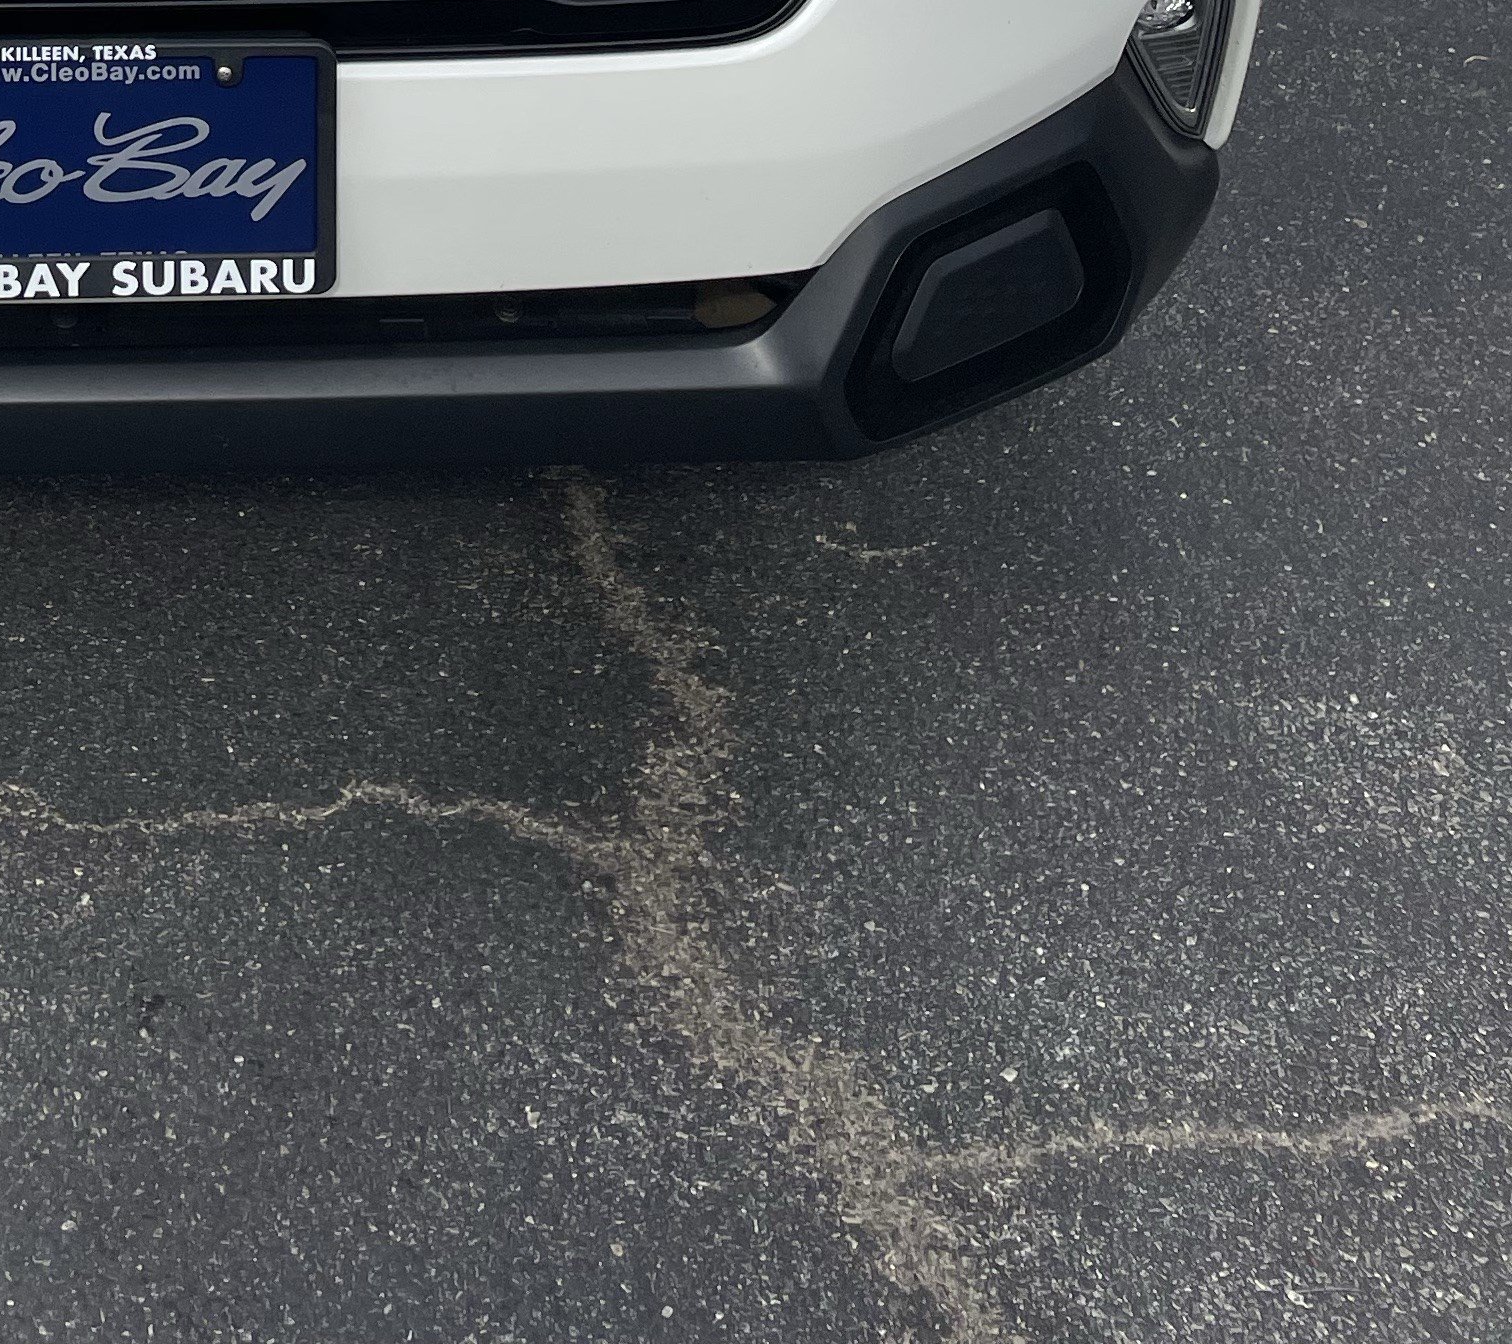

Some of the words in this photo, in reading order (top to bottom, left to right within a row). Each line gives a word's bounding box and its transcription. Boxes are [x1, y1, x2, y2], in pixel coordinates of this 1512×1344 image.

[1, 46, 86, 63] KILLEEN,
[92, 44, 157, 61] TEXAS
[82, 112, 307, 222] Bay
[112, 257, 316, 296] SUBARU
